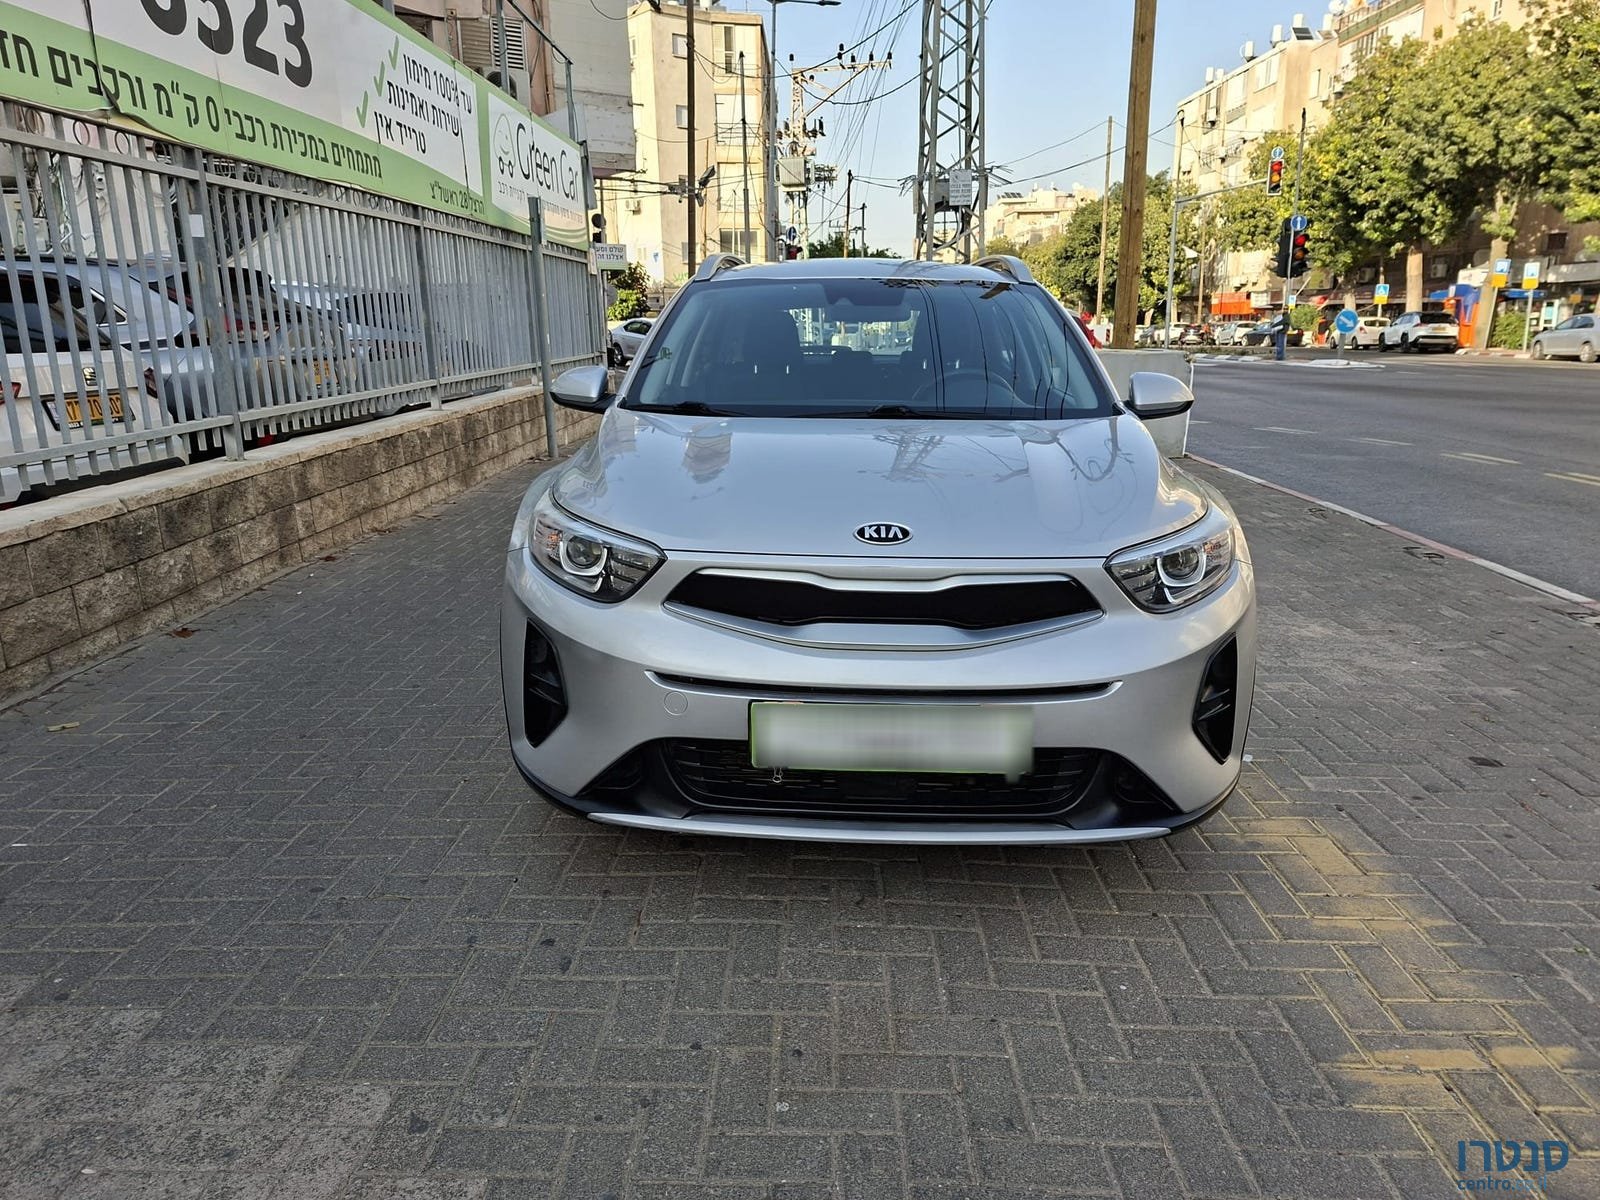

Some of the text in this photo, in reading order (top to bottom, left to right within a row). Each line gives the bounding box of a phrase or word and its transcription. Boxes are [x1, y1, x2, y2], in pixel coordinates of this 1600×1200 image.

[47, 46, 148, 110] ורכבים
[403, 54, 472, 115] עד 100% מימון
[224, 108, 267, 146] רכבי
[387, 80, 460, 137] שירות ואמינות
[270, 122, 329, 164] במכירת
[374, 111, 426, 154] טרייד אין
[331, 142, 383, 178] מתמחים
[516, 122, 579, 203] Green Car
[864, 525, 903, 538] KIA
